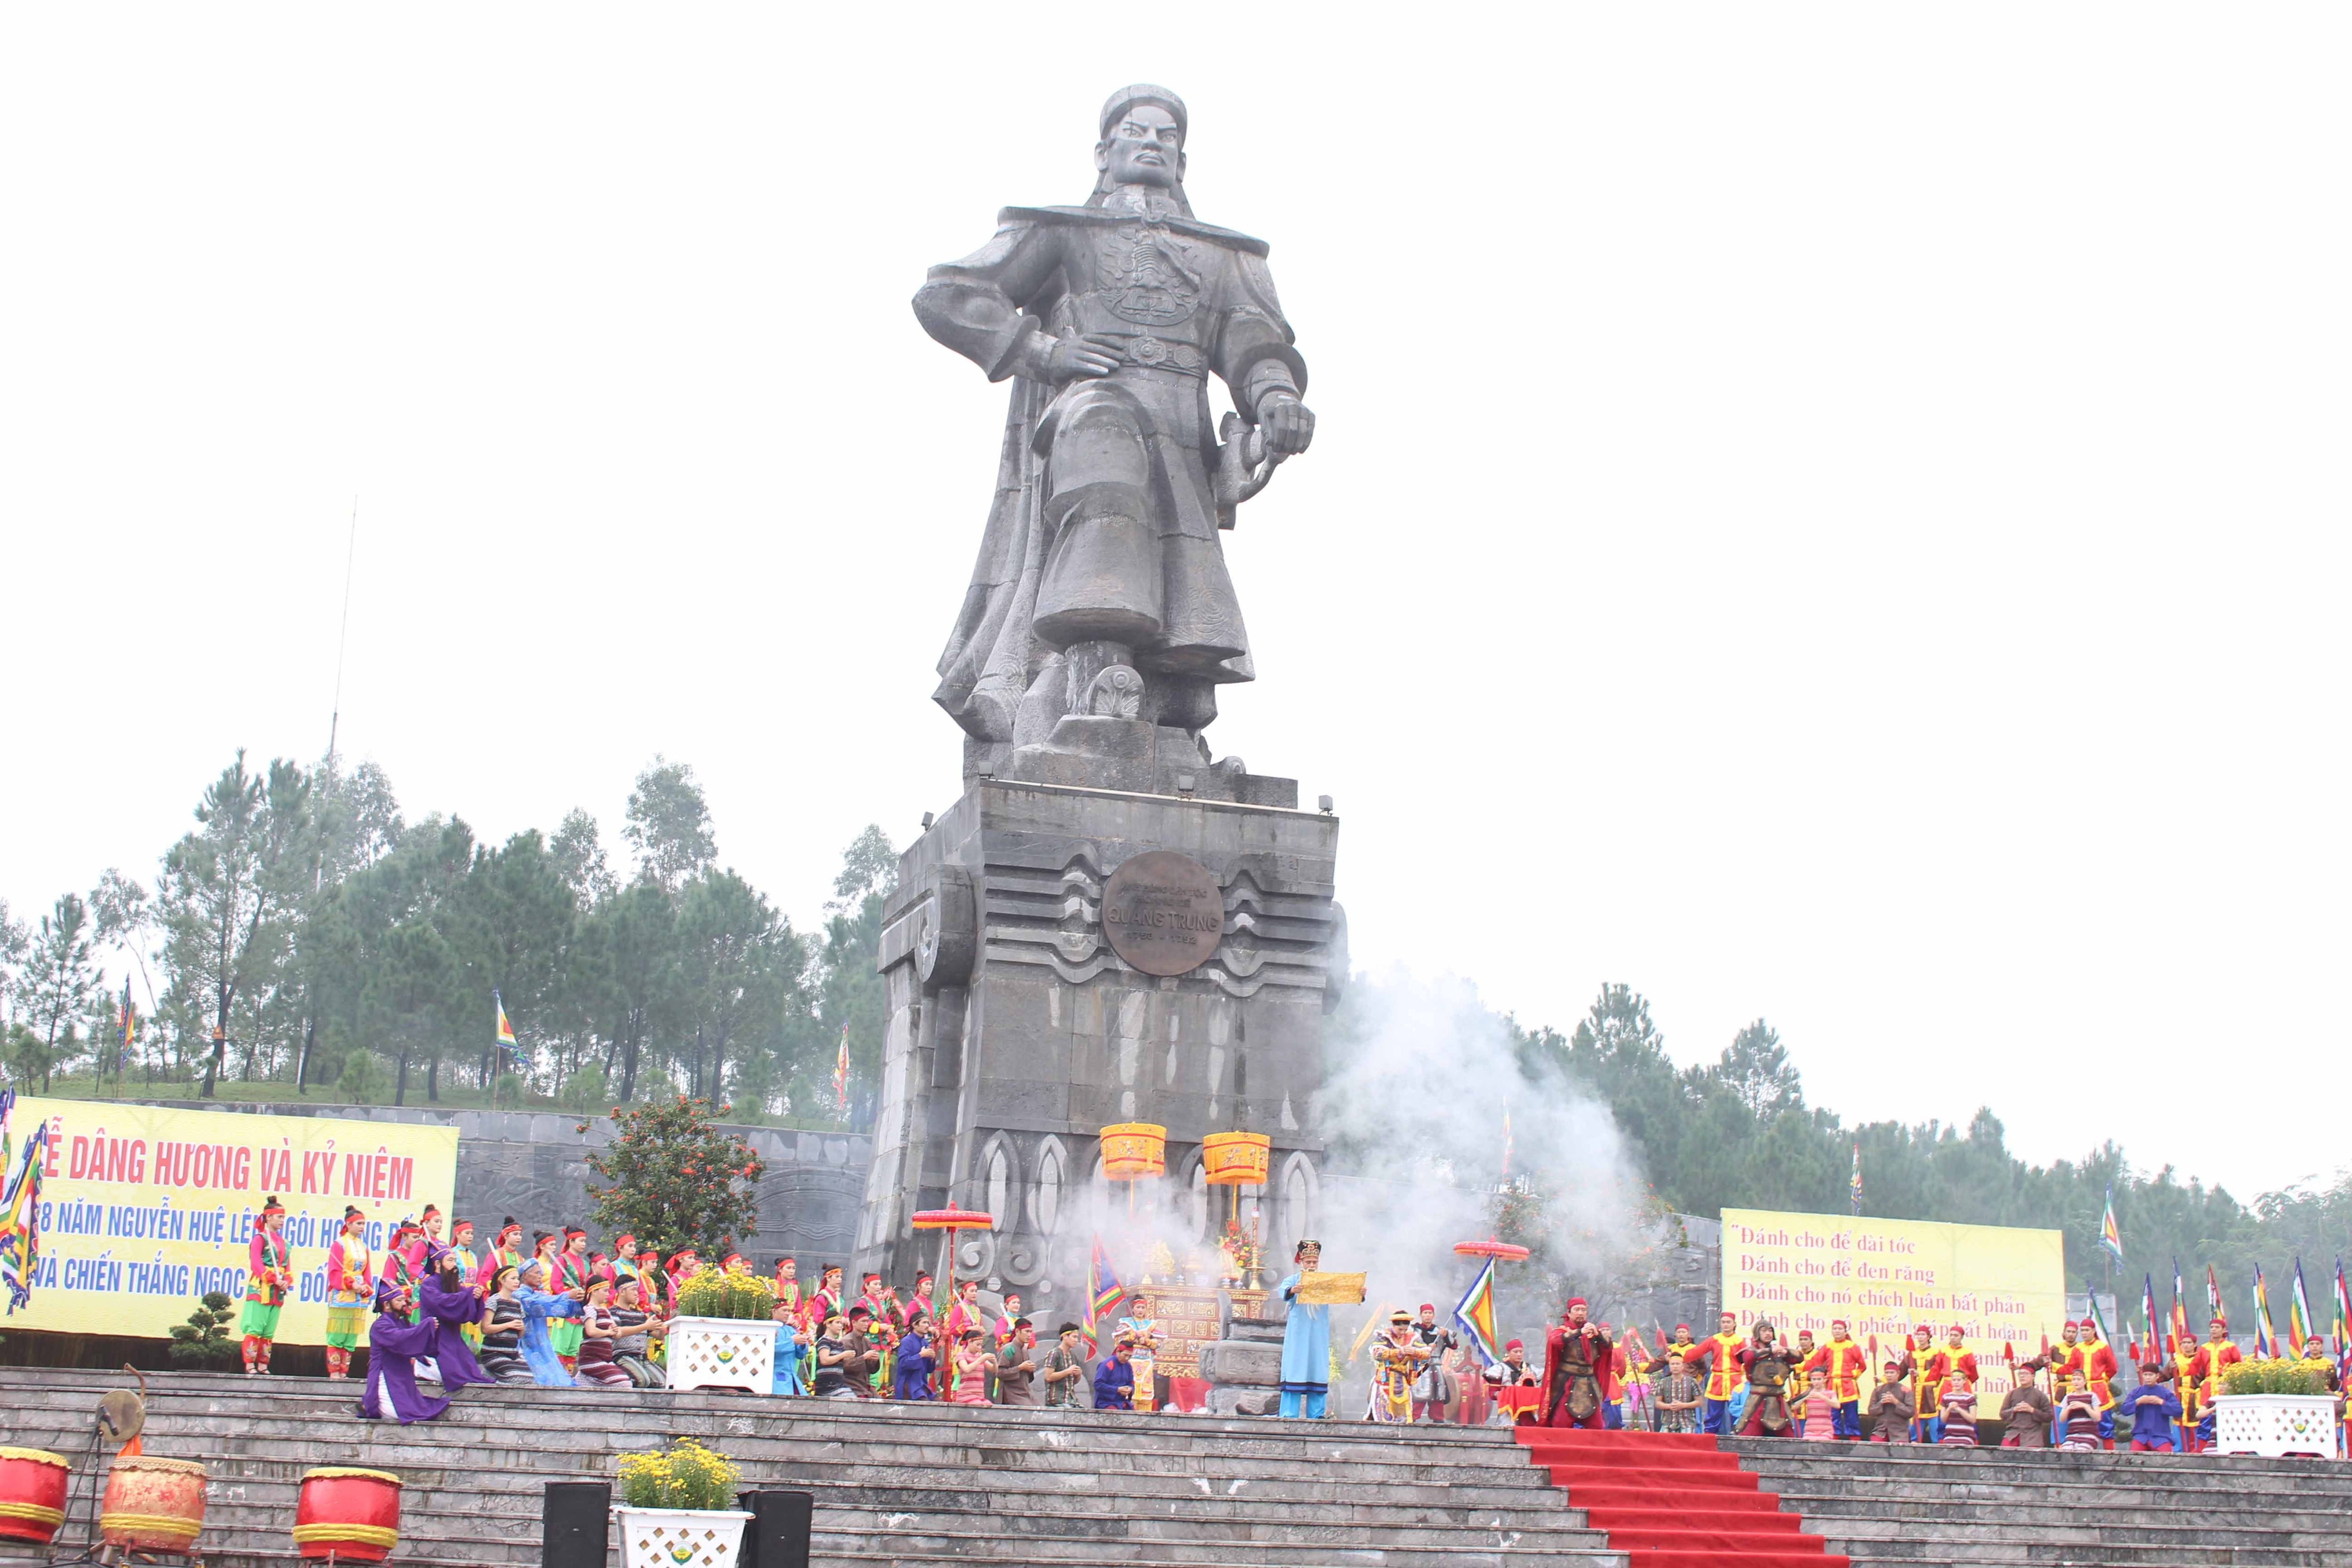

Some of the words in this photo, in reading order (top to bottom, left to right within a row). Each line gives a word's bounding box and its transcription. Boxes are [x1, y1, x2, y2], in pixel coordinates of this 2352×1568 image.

[1108, 907, 1165, 927] QUANG
[1168, 911, 1219, 932] TRUNG
[44, 1116, 63, 1177] Ễ
[70, 1128, 146, 1183] DÂNG
[154, 1142, 250, 1190] HƯƠNG
[261, 1138, 291, 1192] VÀ
[301, 1139, 337, 1194] KỶ
[343, 1146, 413, 1207] NIỆM
[57, 1197, 103, 1235] NĂM
[108, 1197, 184, 1240] NGUYỄN
[189, 1206, 225, 1249] HUỆ
[1795, 1231, 1824, 1248] cho
[1831, 1230, 1851, 1250] để
[1858, 1235, 1883, 1251] dài
[1890, 1237, 1915, 1254] tóc
[35, 1249, 57, 1288] VÀ
[64, 1250, 122, 1291] CHIẾN
[128, 1250, 188, 1296] THẮNG
[1741, 1255, 1788, 1274] Đánh
[1795, 1258, 1824, 1275] cho
[1831, 1257, 1852, 1277] để
[1895, 1266, 1934, 1286] răng
[1741, 1282, 1789, 1301] Đánh
[1795, 1286, 1825, 1303] cho
[1832, 1288, 1851, 1304] nó
[1859, 1289, 1903, 1307] chích
[1909, 1292, 1945, 1309] luân
[1952, 1292, 1978, 1311] bất
[1985, 1295, 2025, 1316] phản
[1796, 1313, 1825, 1329] cho
[1859, 1315, 1907, 1336] phiến
[1883, 1344, 1906, 1361] Na
[1975, 1350, 2004, 1366] anh
